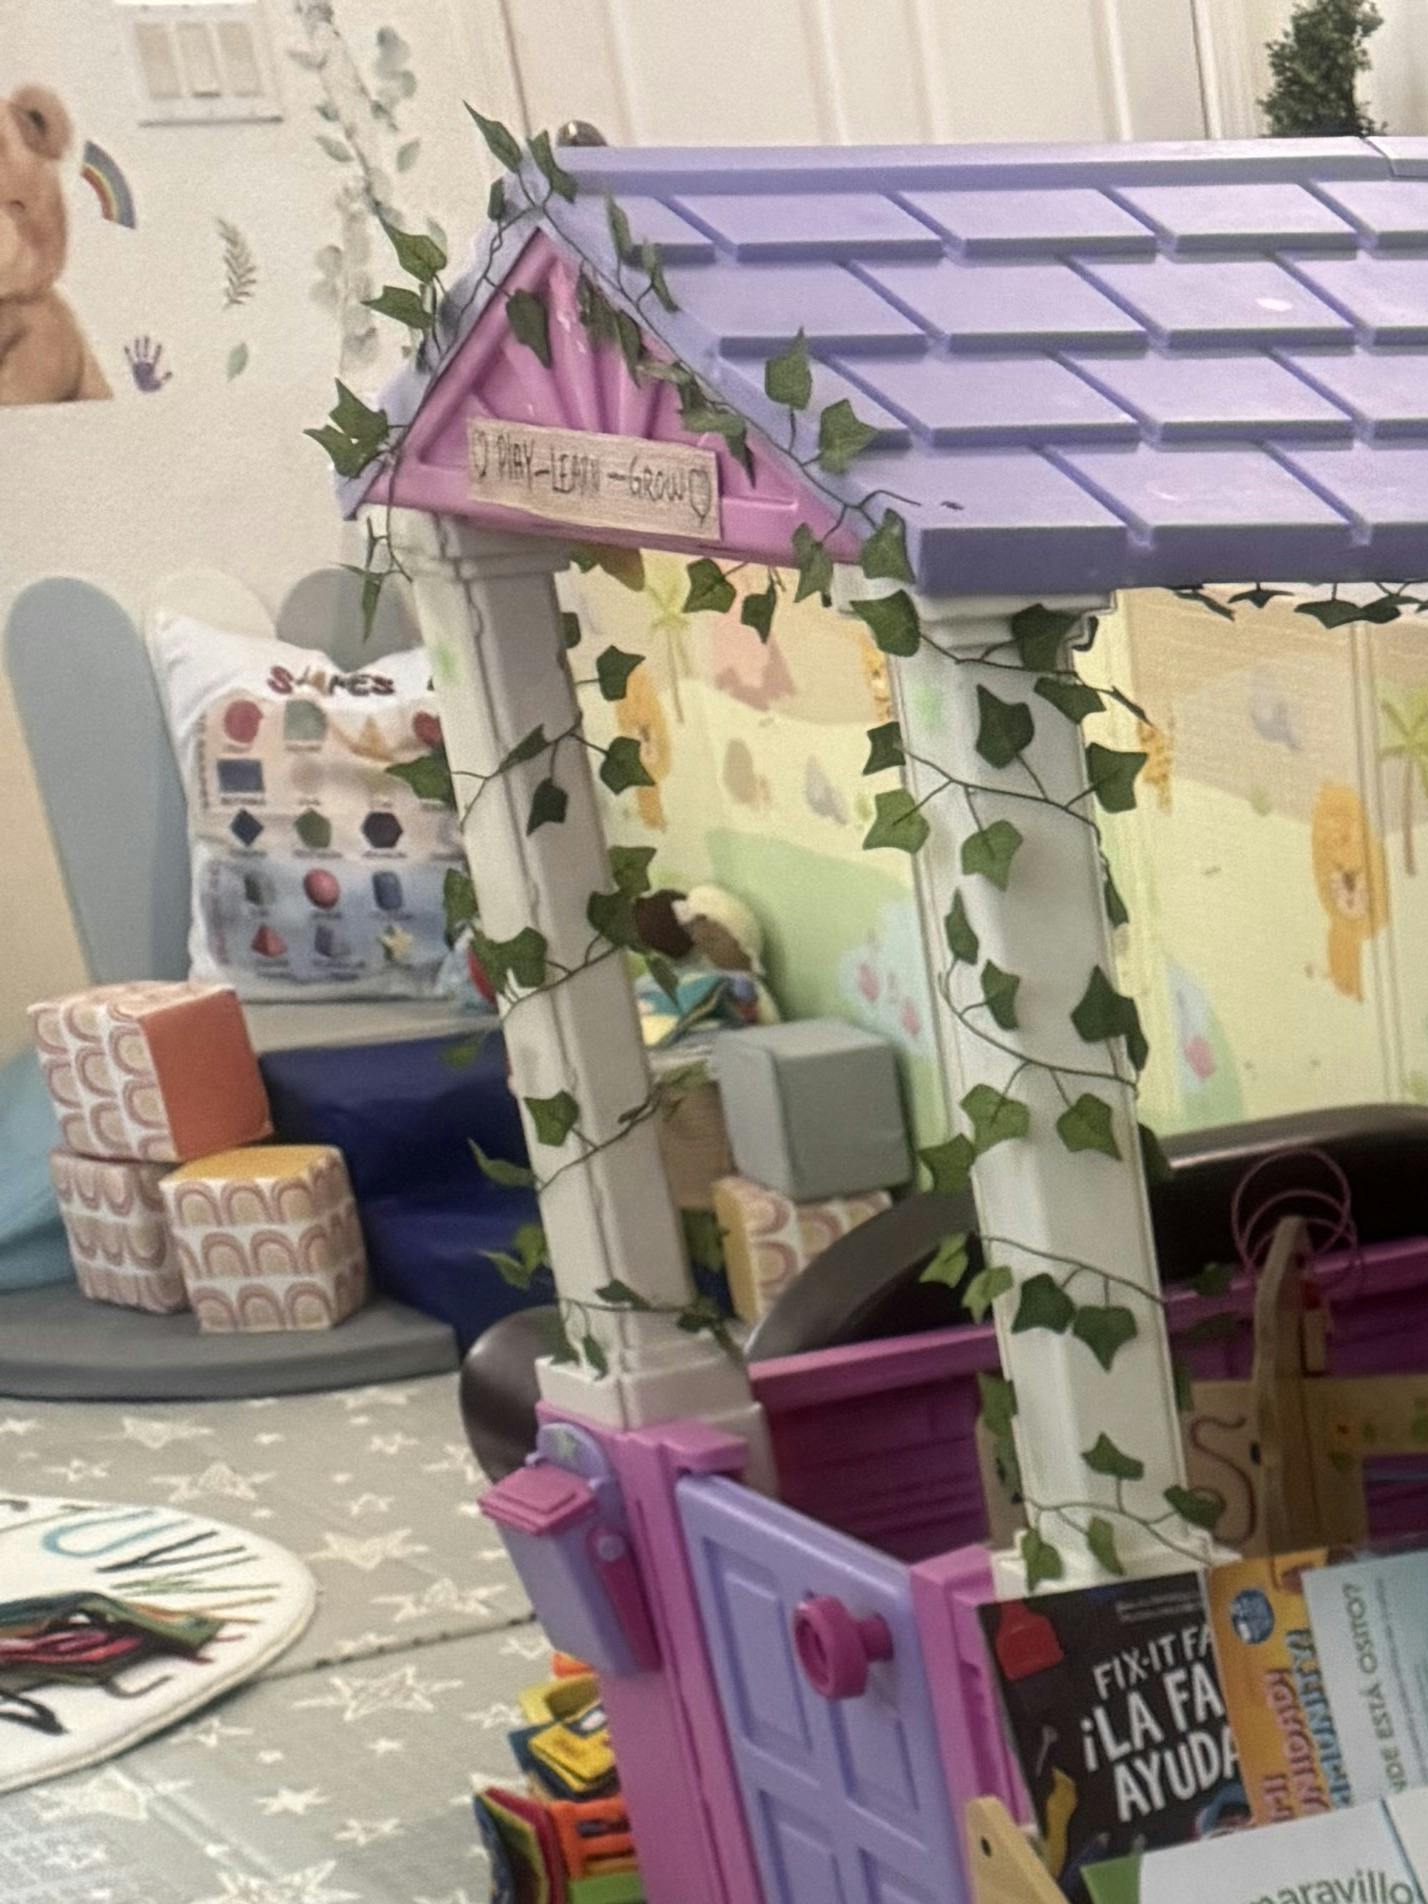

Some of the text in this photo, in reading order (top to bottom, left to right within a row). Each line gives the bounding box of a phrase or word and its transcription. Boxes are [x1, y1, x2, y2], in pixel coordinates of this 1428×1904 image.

[1342, 1583, 1380, 1676] OSITO?
[1081, 1662, 1227, 1773] ¡LA FA
[1359, 1681, 1396, 1741] ESTÁ
